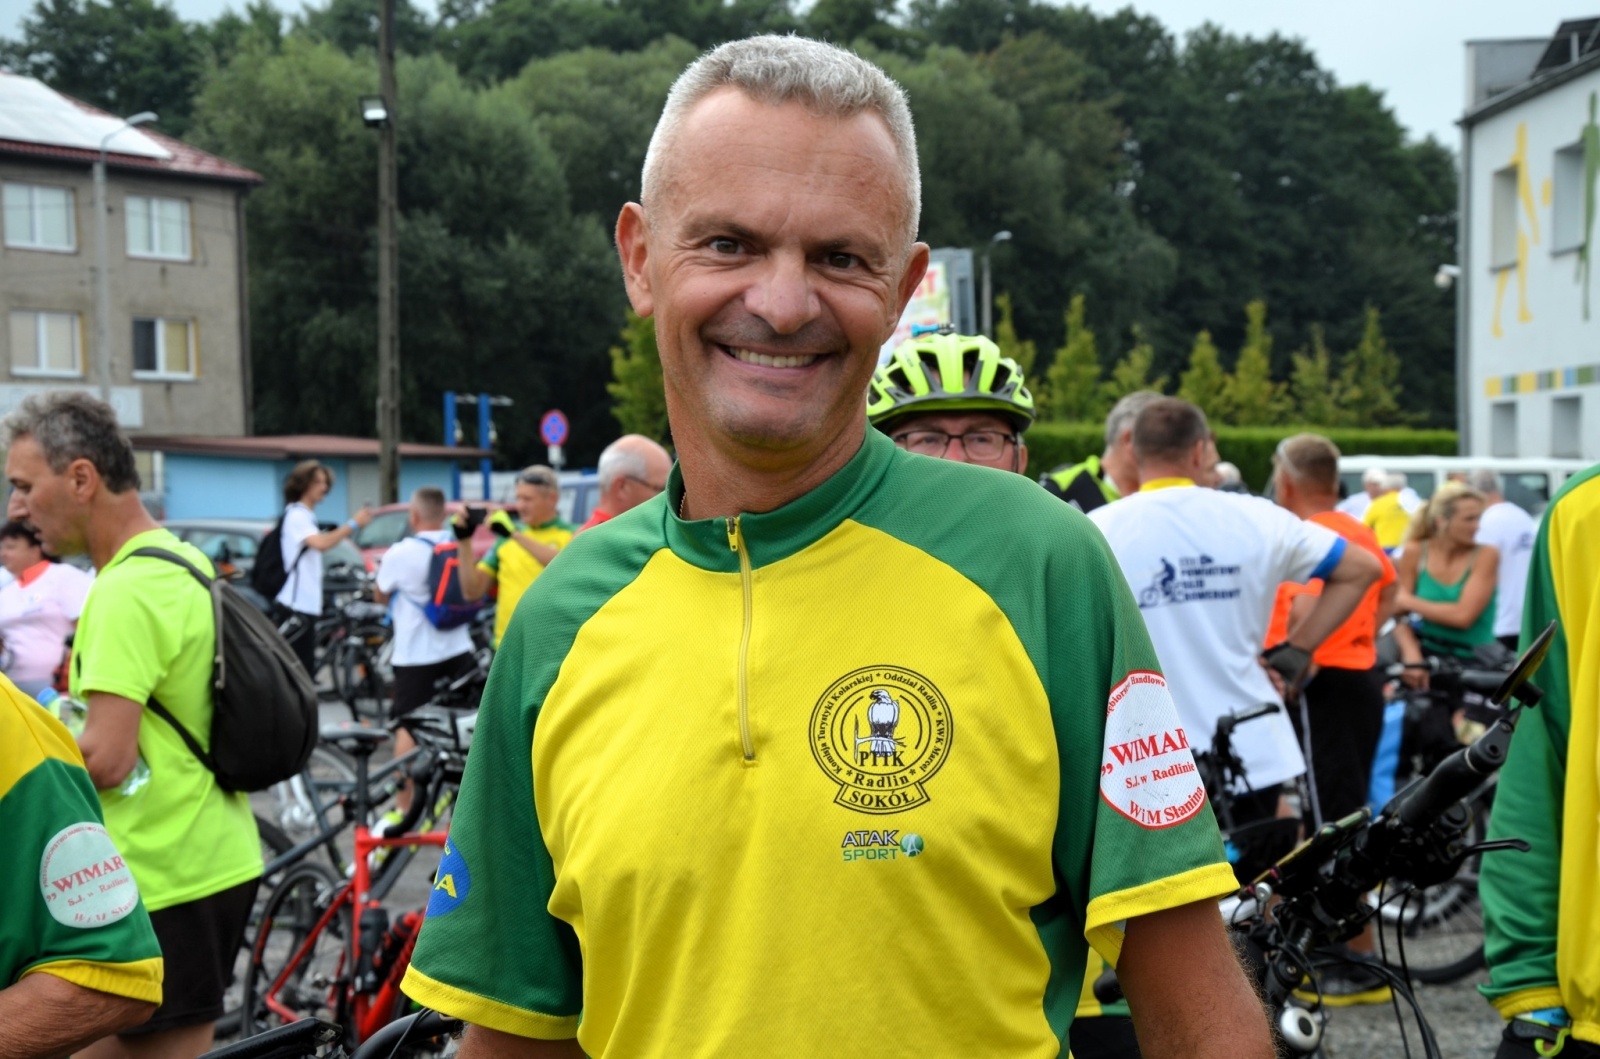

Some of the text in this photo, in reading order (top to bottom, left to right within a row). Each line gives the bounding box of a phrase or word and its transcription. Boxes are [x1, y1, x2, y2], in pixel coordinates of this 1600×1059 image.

[1130, 675, 1165, 687] Handlowo
[917, 685, 938, 711] Radlin
[817, 674, 873, 775] Komisja Turystyki Kolarskiej
[919, 719, 945, 773] KWK Marcel
[859, 751, 905, 767] PTTK
[1151, 761, 1195, 781] Radlinie
[853, 773, 909, 788] Radlin
[849, 790, 915, 808] SOKÓŁ
[841, 829, 900, 848] ATAK
[843, 848, 898, 862] SPORT
